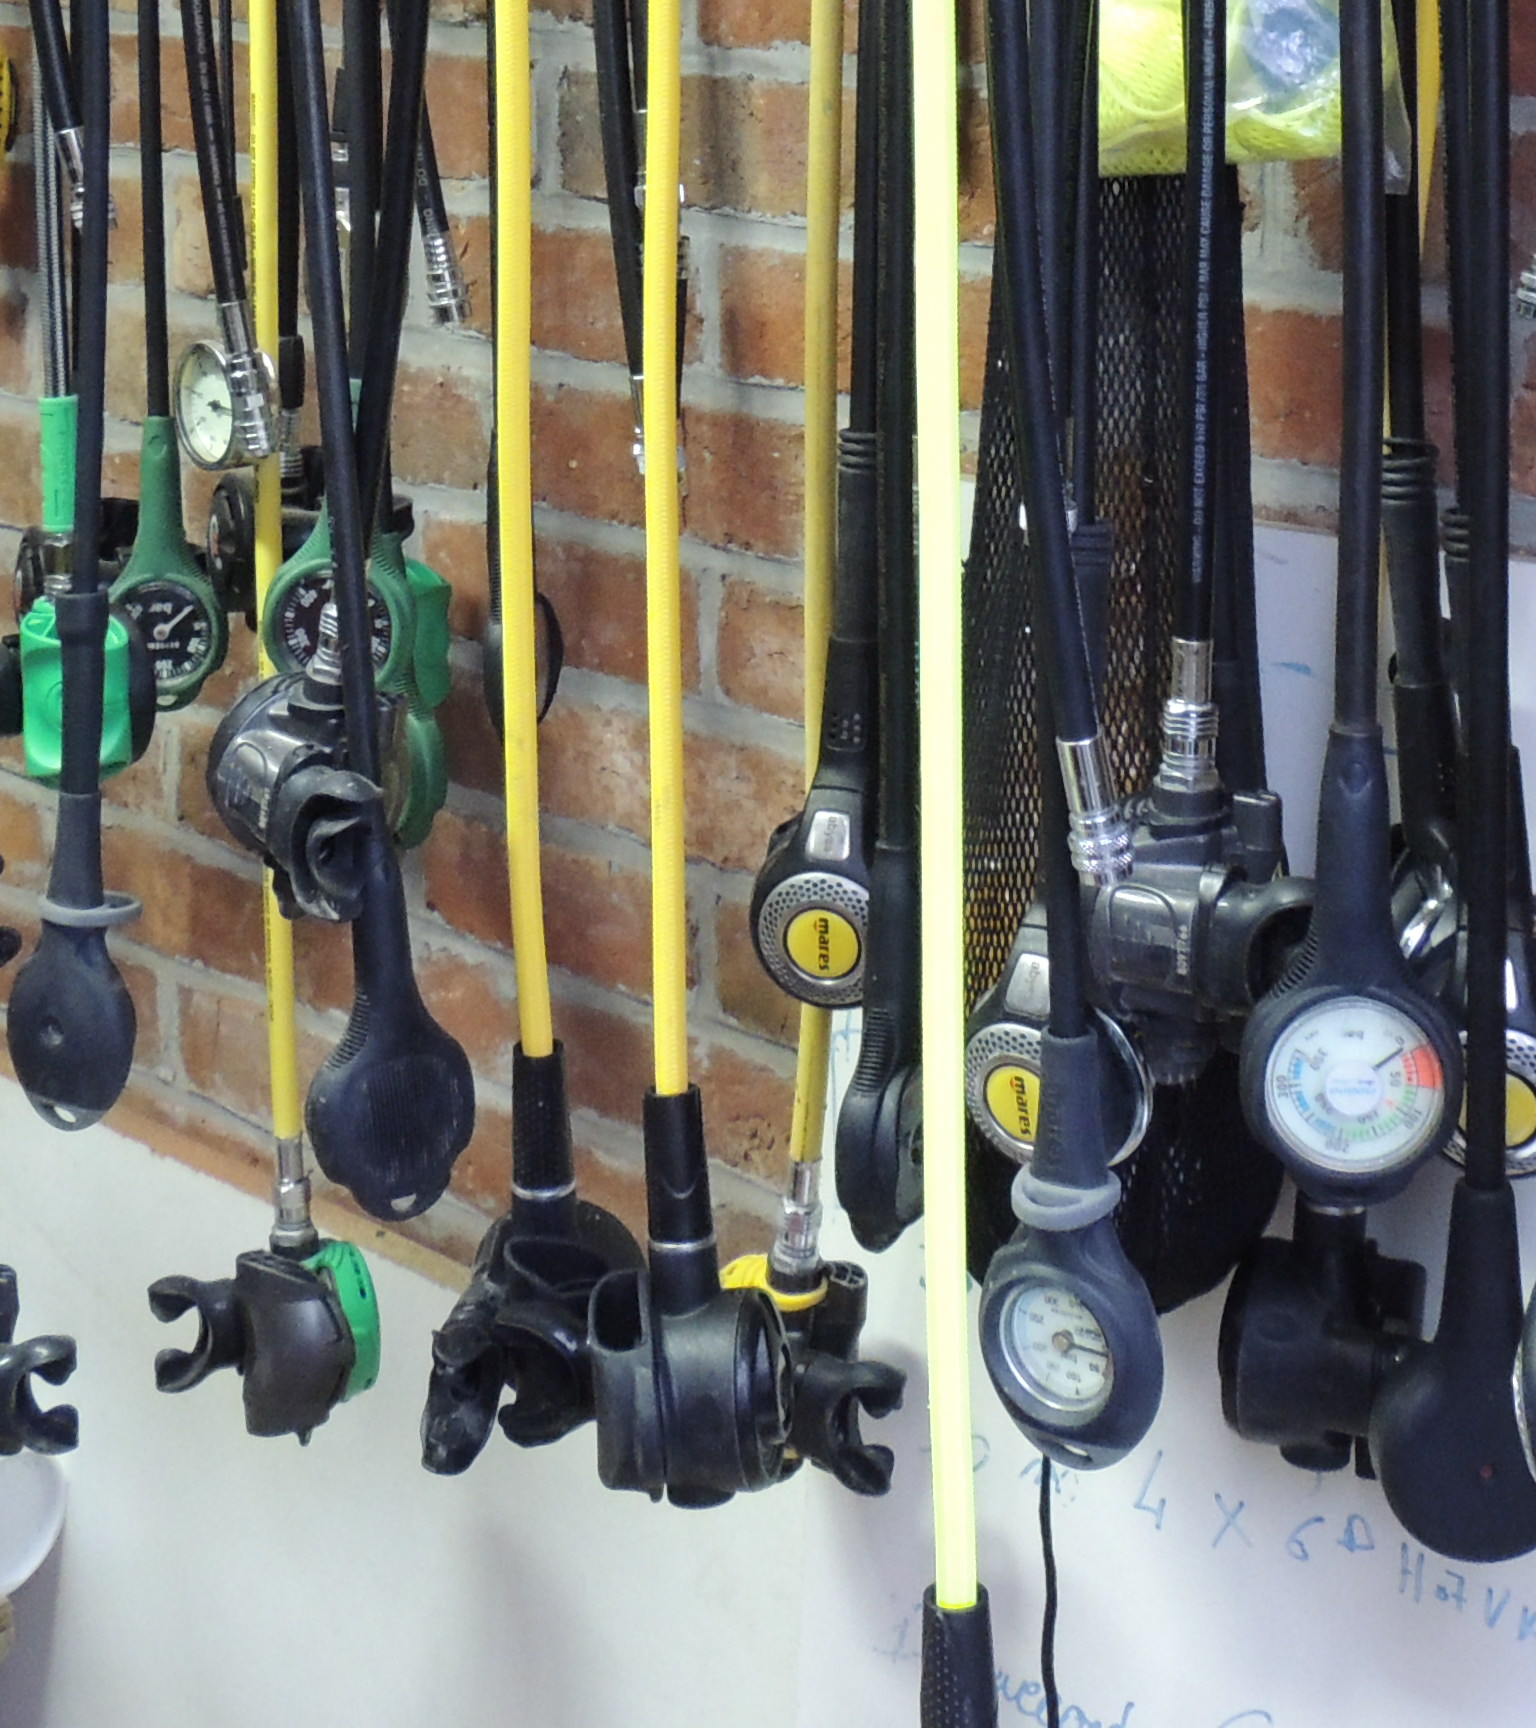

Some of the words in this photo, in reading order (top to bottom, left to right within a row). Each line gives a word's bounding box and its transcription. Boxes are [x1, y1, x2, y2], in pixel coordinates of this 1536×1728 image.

[817, 917, 830, 972] mares
[1275, 1074, 1289, 1100] 300
[1388, 1071, 1402, 1087] 50
[1014, 1075, 1032, 1137] mares
[1404, 1108, 1423, 1130] 100
[1324, 1139, 1350, 1153] 200
